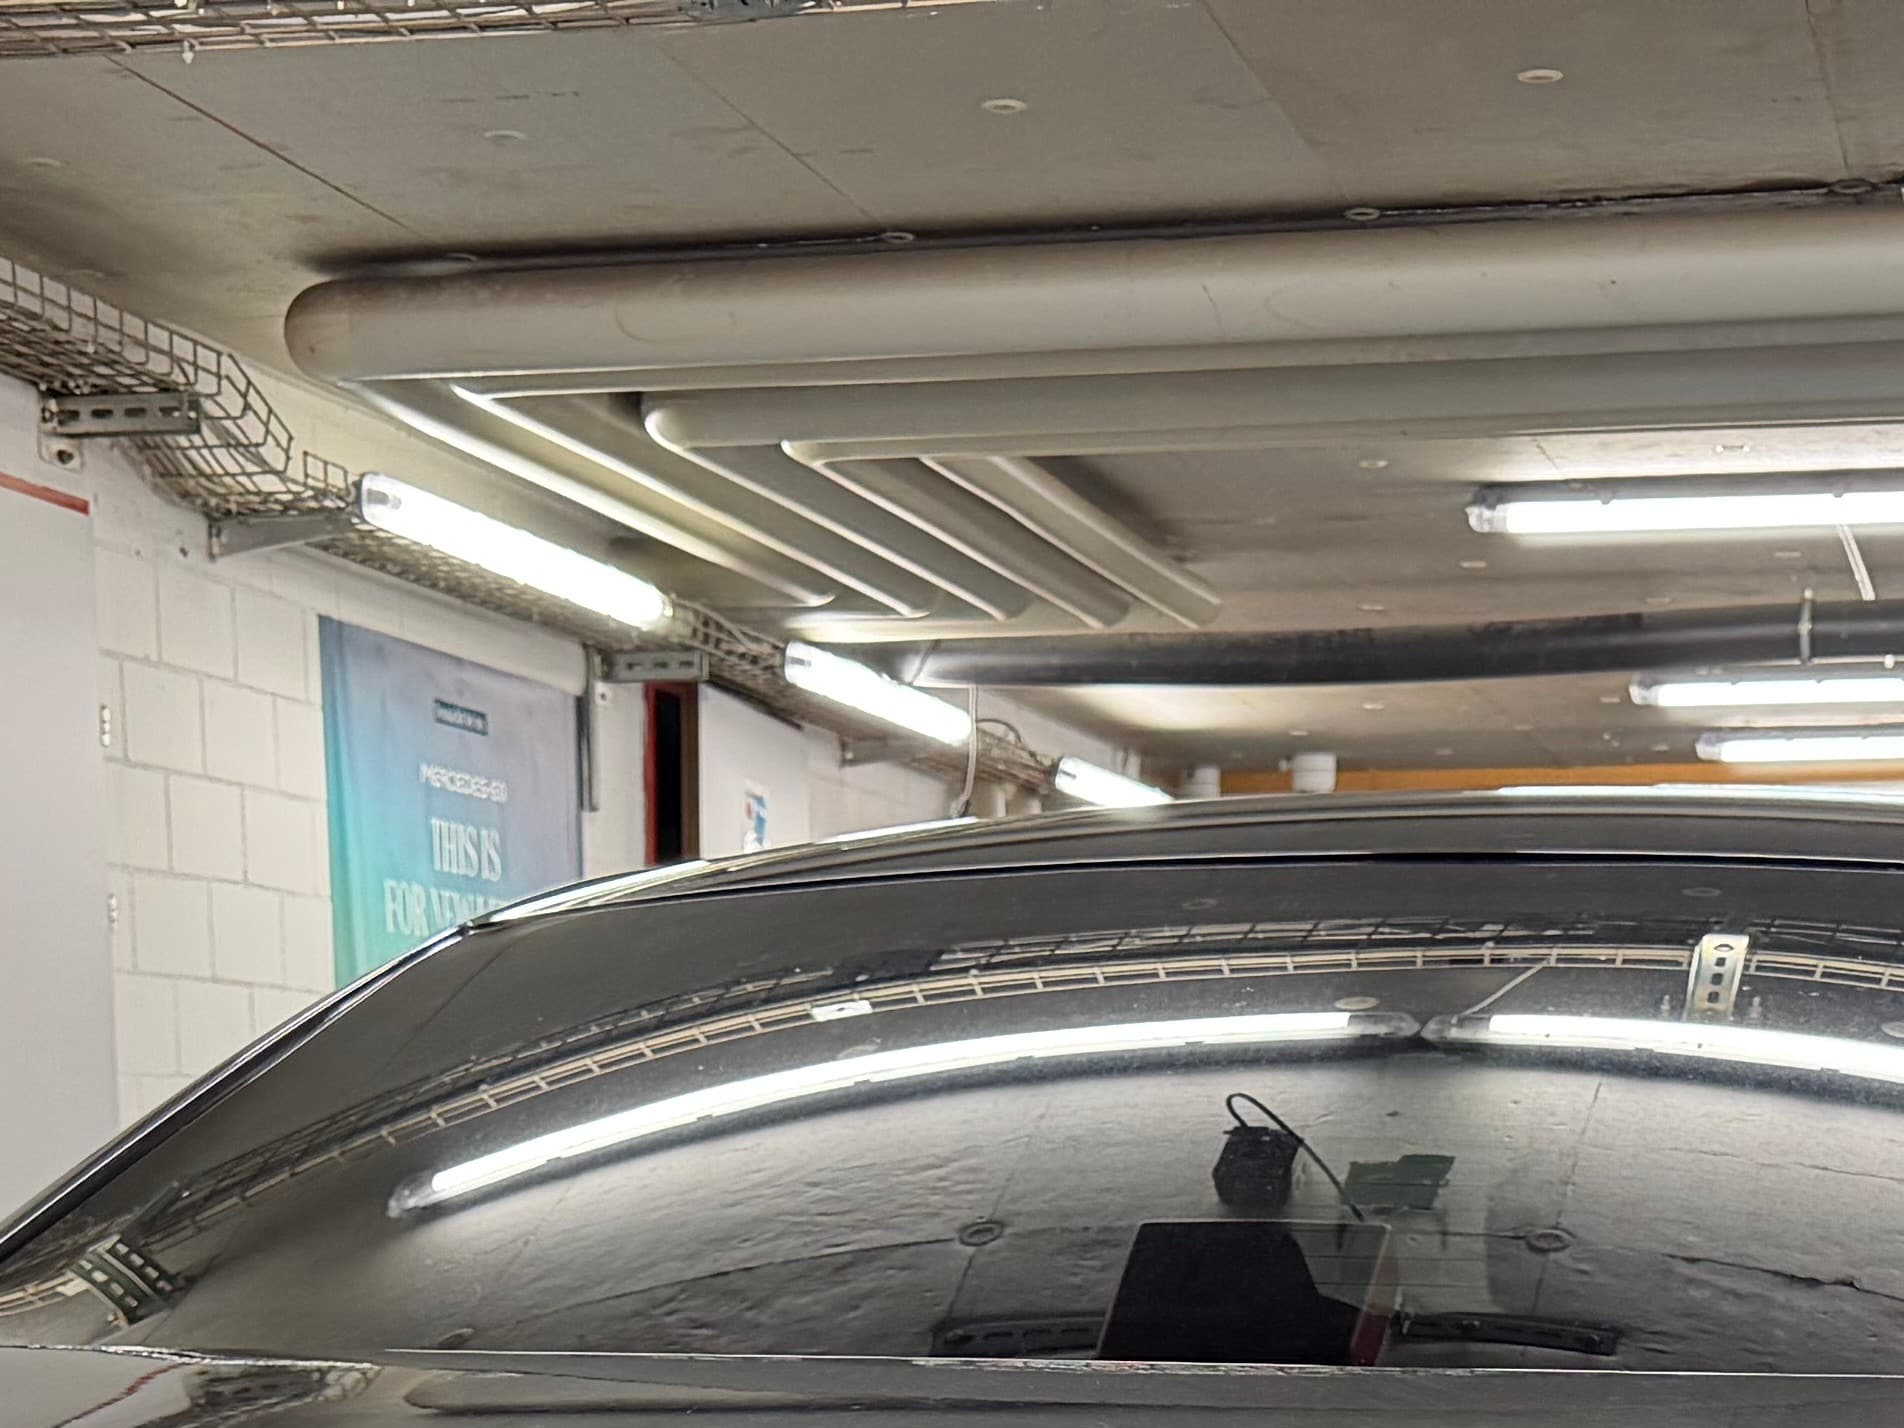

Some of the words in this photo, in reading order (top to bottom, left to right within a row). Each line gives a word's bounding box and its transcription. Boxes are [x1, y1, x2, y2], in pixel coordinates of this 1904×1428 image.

[431, 818, 478, 876] THIS
[482, 829, 502, 881] IS
[383, 879, 430, 936] FOR
